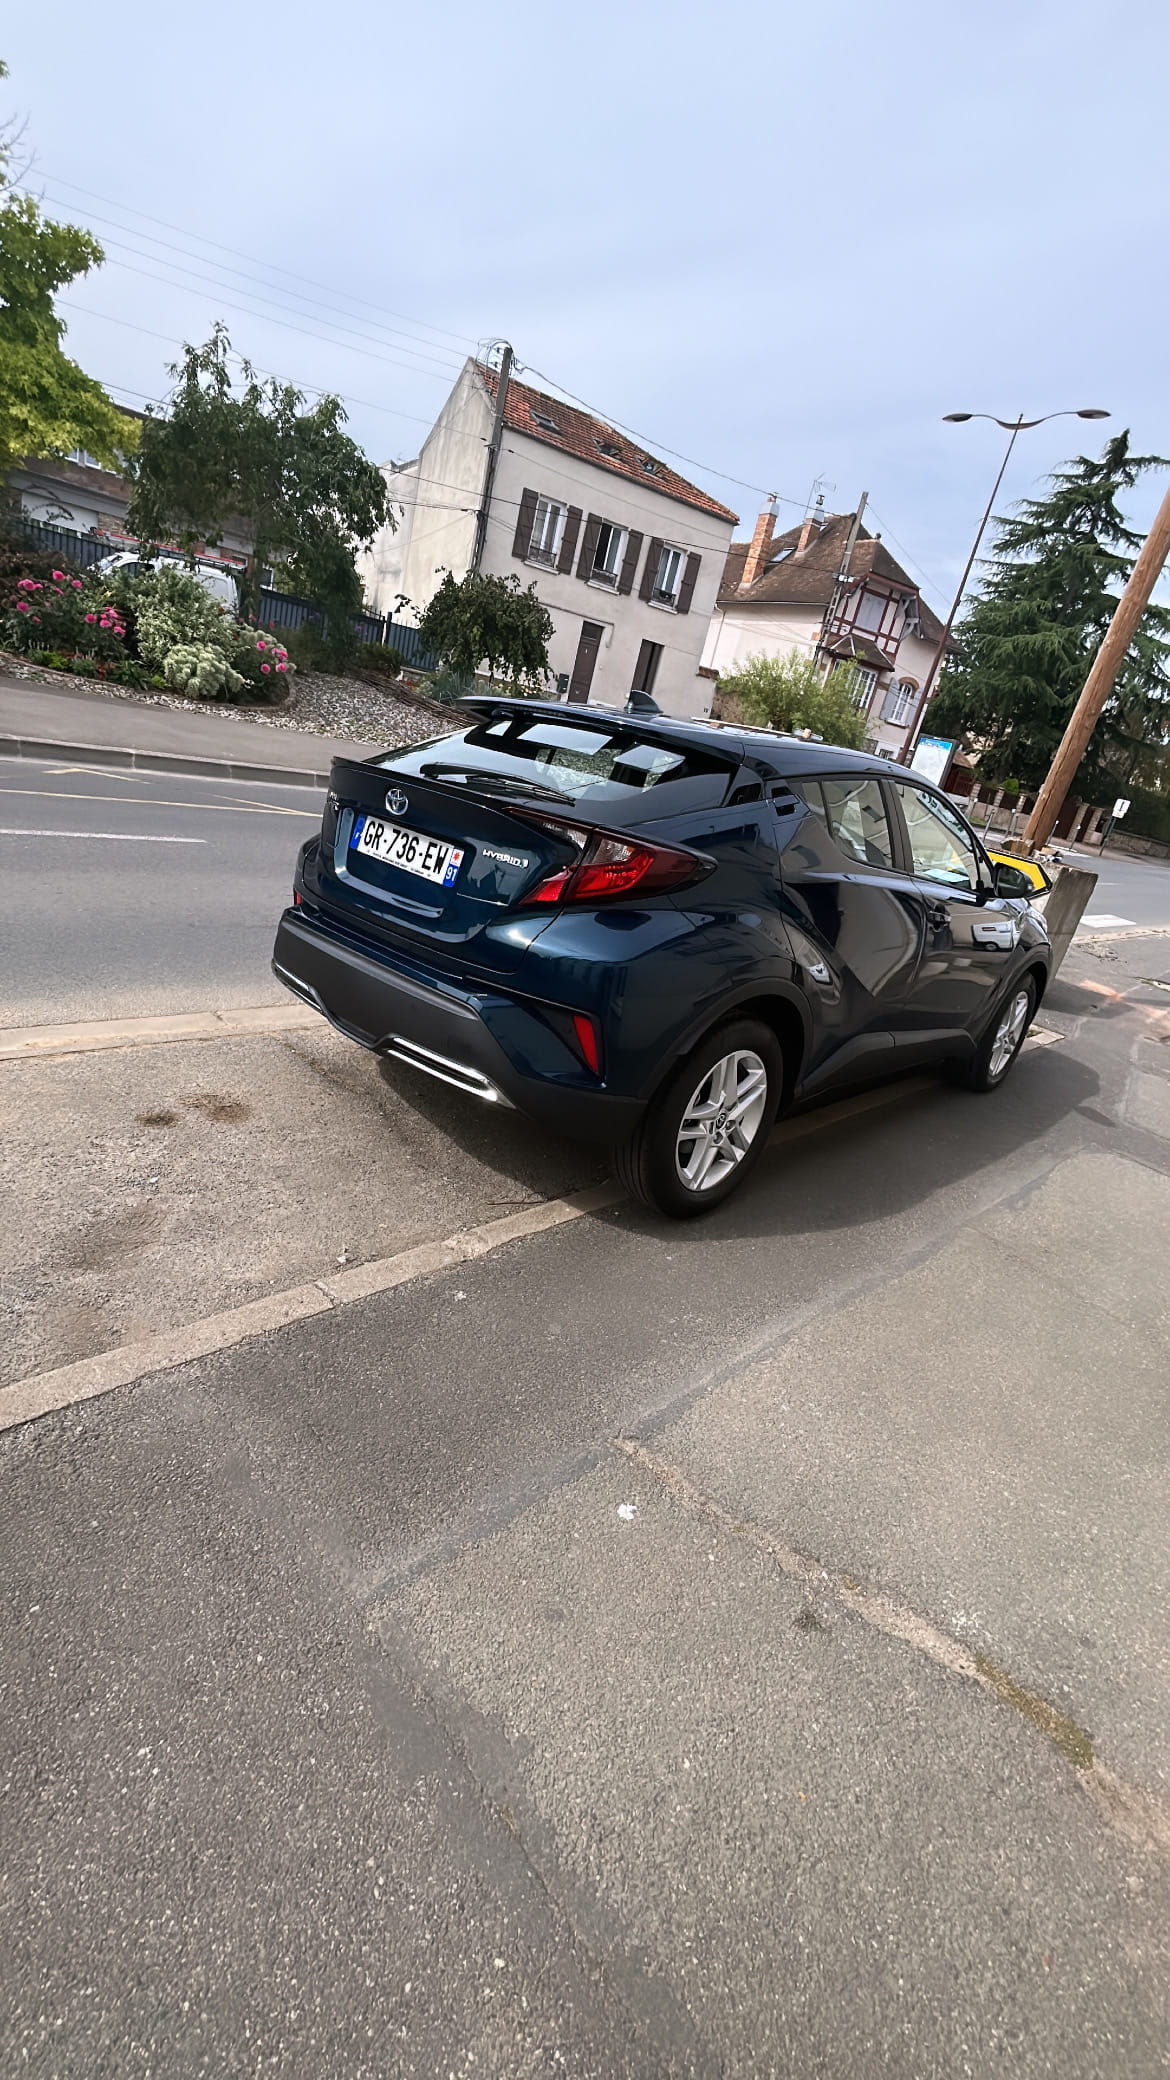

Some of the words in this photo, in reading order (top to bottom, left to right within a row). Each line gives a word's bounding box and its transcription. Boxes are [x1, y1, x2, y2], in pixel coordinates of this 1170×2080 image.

[363, 820, 449, 874] GR-736-EW
[482, 849, 521, 867] HYBRID
[445, 866, 458, 881] 91
